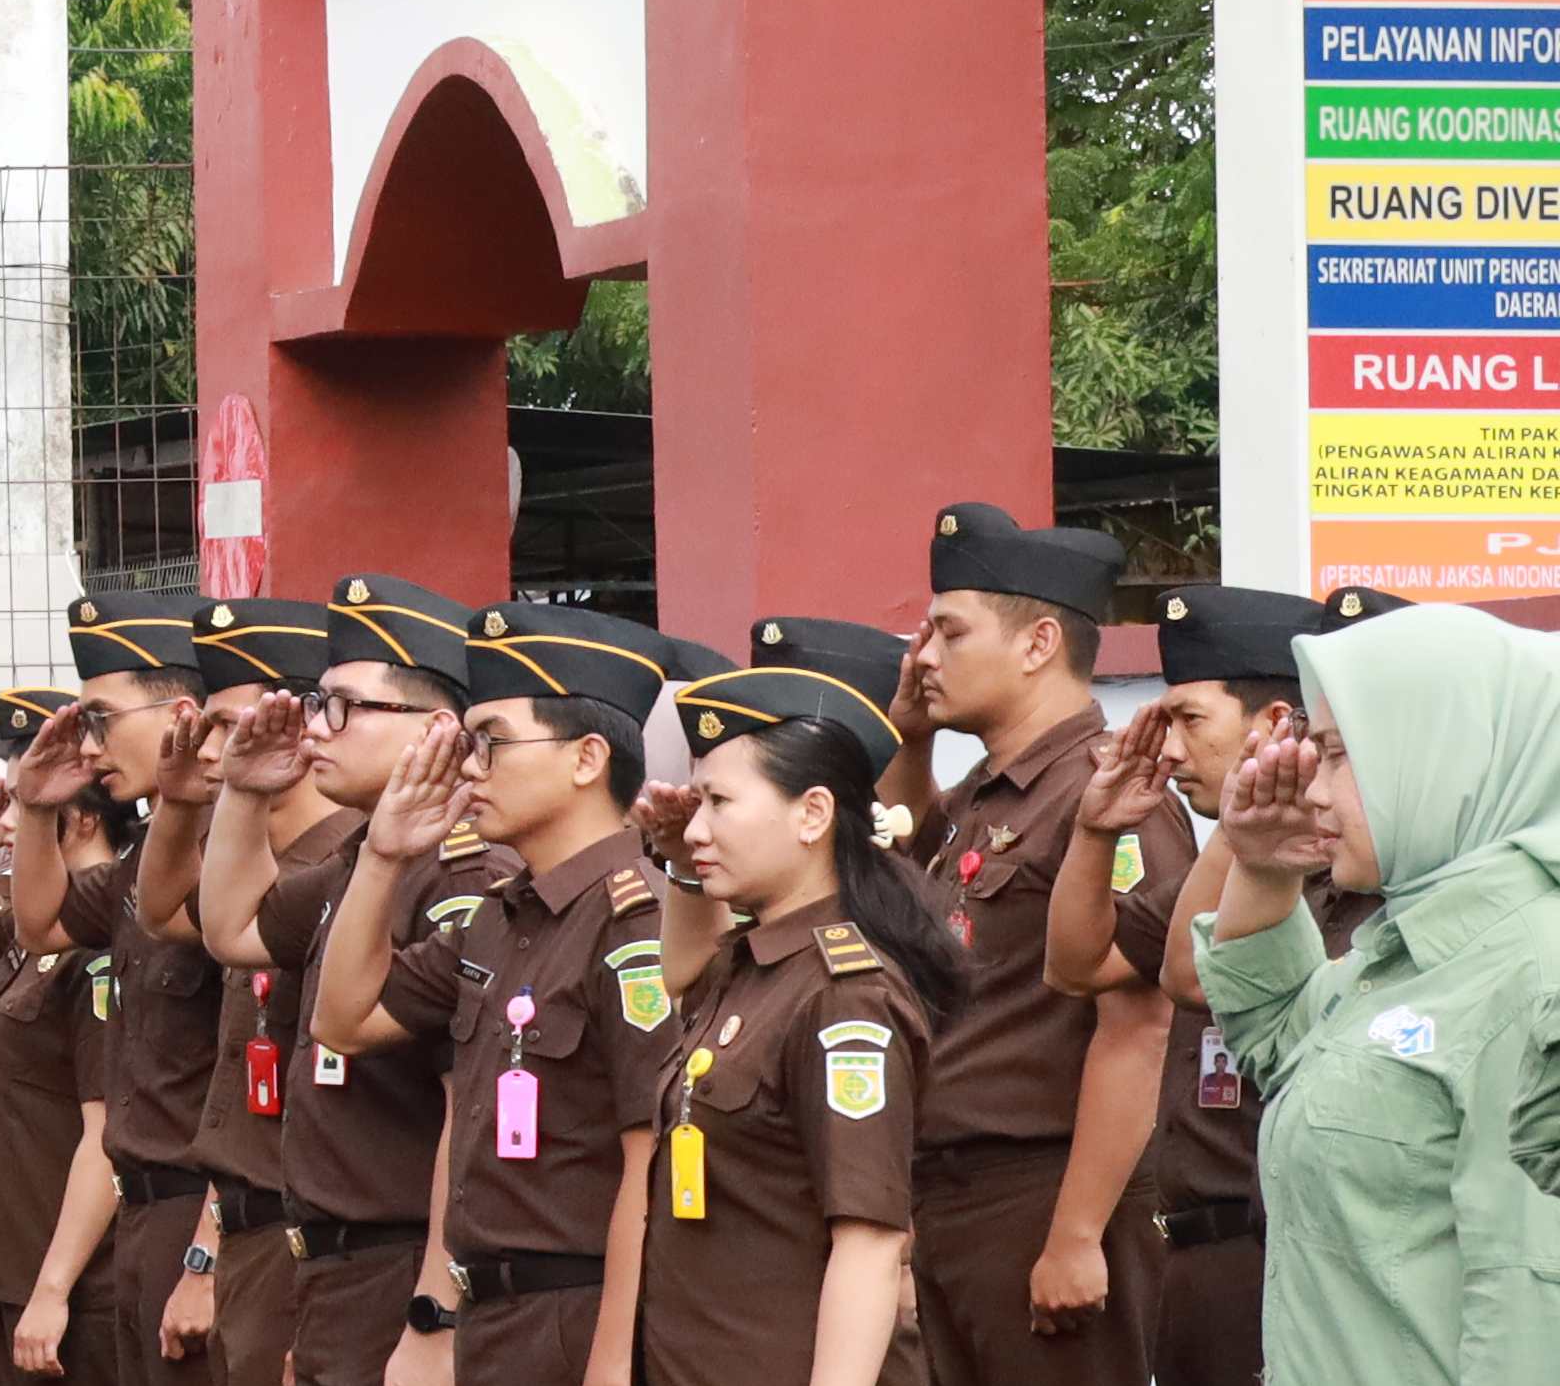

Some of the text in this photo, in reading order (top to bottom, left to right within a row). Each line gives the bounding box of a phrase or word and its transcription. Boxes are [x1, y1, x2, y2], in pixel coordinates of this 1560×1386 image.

[1322, 25, 1482, 63] PELAYANAN
[1318, 106, 1411, 142] RUANG
[1330, 185, 1560, 221] RUANG DIVE
[1317, 257, 1438, 285] SEKRETARIAT
[1441, 258, 1486, 285] UNIT
[1495, 291, 1560, 319] DAERA
[1353, 354, 1518, 392] RUANG
[1480, 427, 1560, 442] TIM PAK
[1317, 444, 1466, 461] (PENGAWASAN
[1472, 446, 1547, 460] ALIRAN
[1315, 466, 1389, 481] ALIRAN
[1395, 467, 1525, 481] KEAGAMAAN
[1311, 484, 1399, 498] TINGKAT
[1404, 484, 1523, 499] KABUPATEN
[1318, 564, 1433, 591] (PERSATUAN
[1436, 565, 1494, 589] JAKSA
